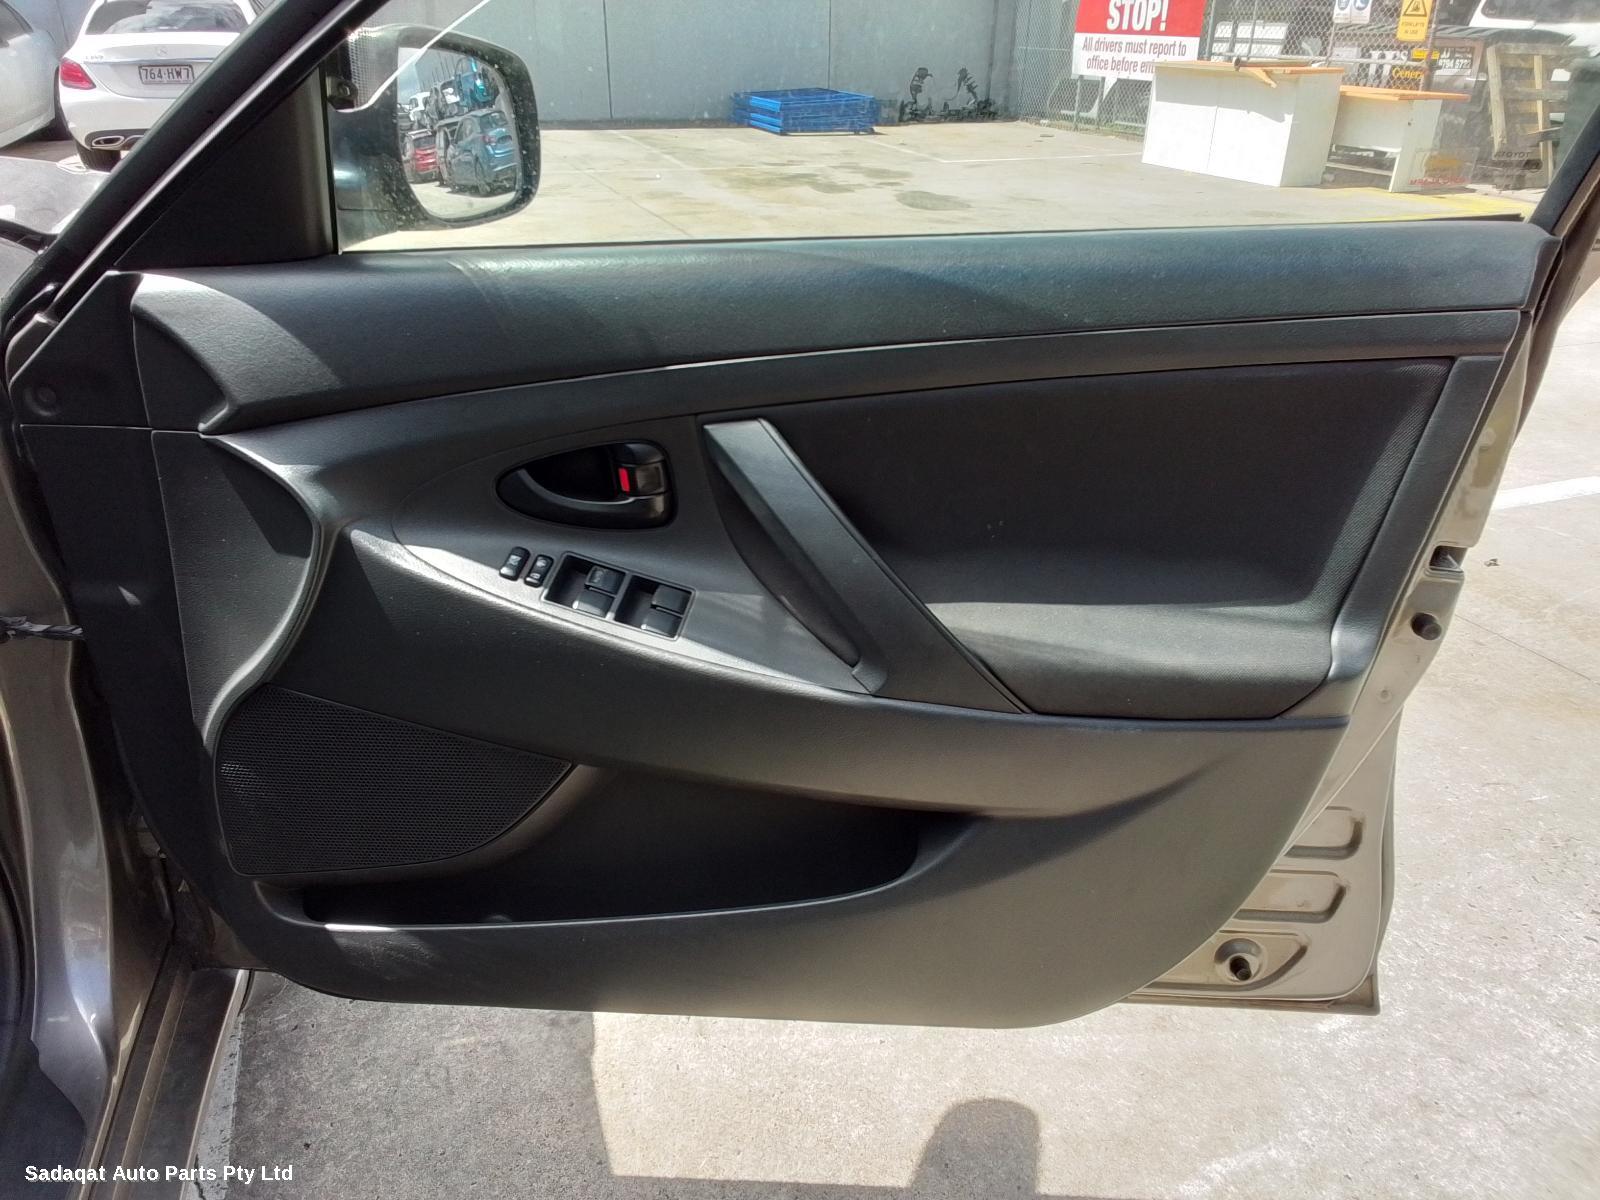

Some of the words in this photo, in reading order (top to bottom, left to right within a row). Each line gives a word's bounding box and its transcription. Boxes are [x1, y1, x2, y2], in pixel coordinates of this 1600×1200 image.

[1106, 0, 1168, 31] STOP!
[1082, 36, 1092, 51] All
[1094, 37, 1123, 53] drivers
[1124, 40, 1147, 55] must
[1148, 41, 1177, 58] report
[1178, 41, 1187, 56] to
[1086, 55, 1109, 70] office
[1110, 56, 1139, 73] before
